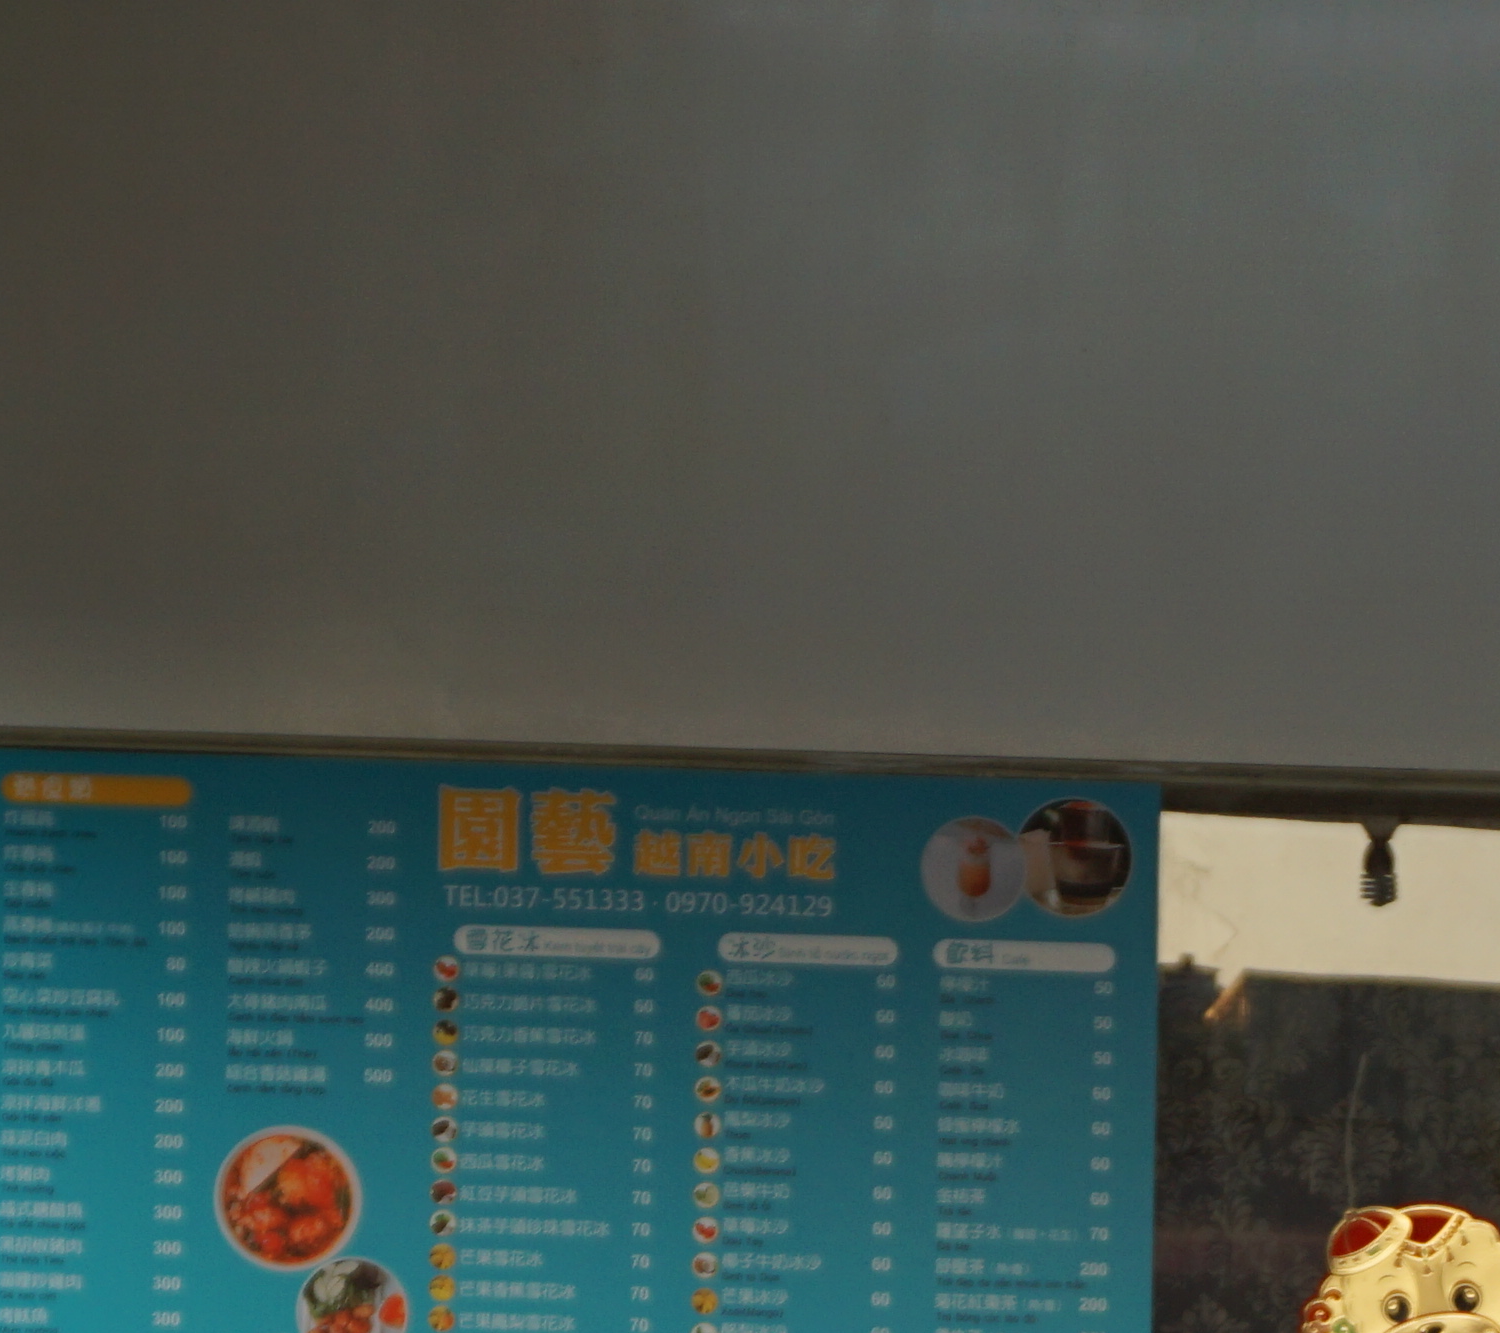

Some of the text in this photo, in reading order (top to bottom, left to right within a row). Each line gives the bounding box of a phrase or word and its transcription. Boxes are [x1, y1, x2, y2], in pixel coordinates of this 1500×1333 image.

[437, 784, 617, 878] 園藝
[632, 829, 837, 884] 越南小吃
[443, 884, 834, 919] TEL:037-551333 0970-924129
